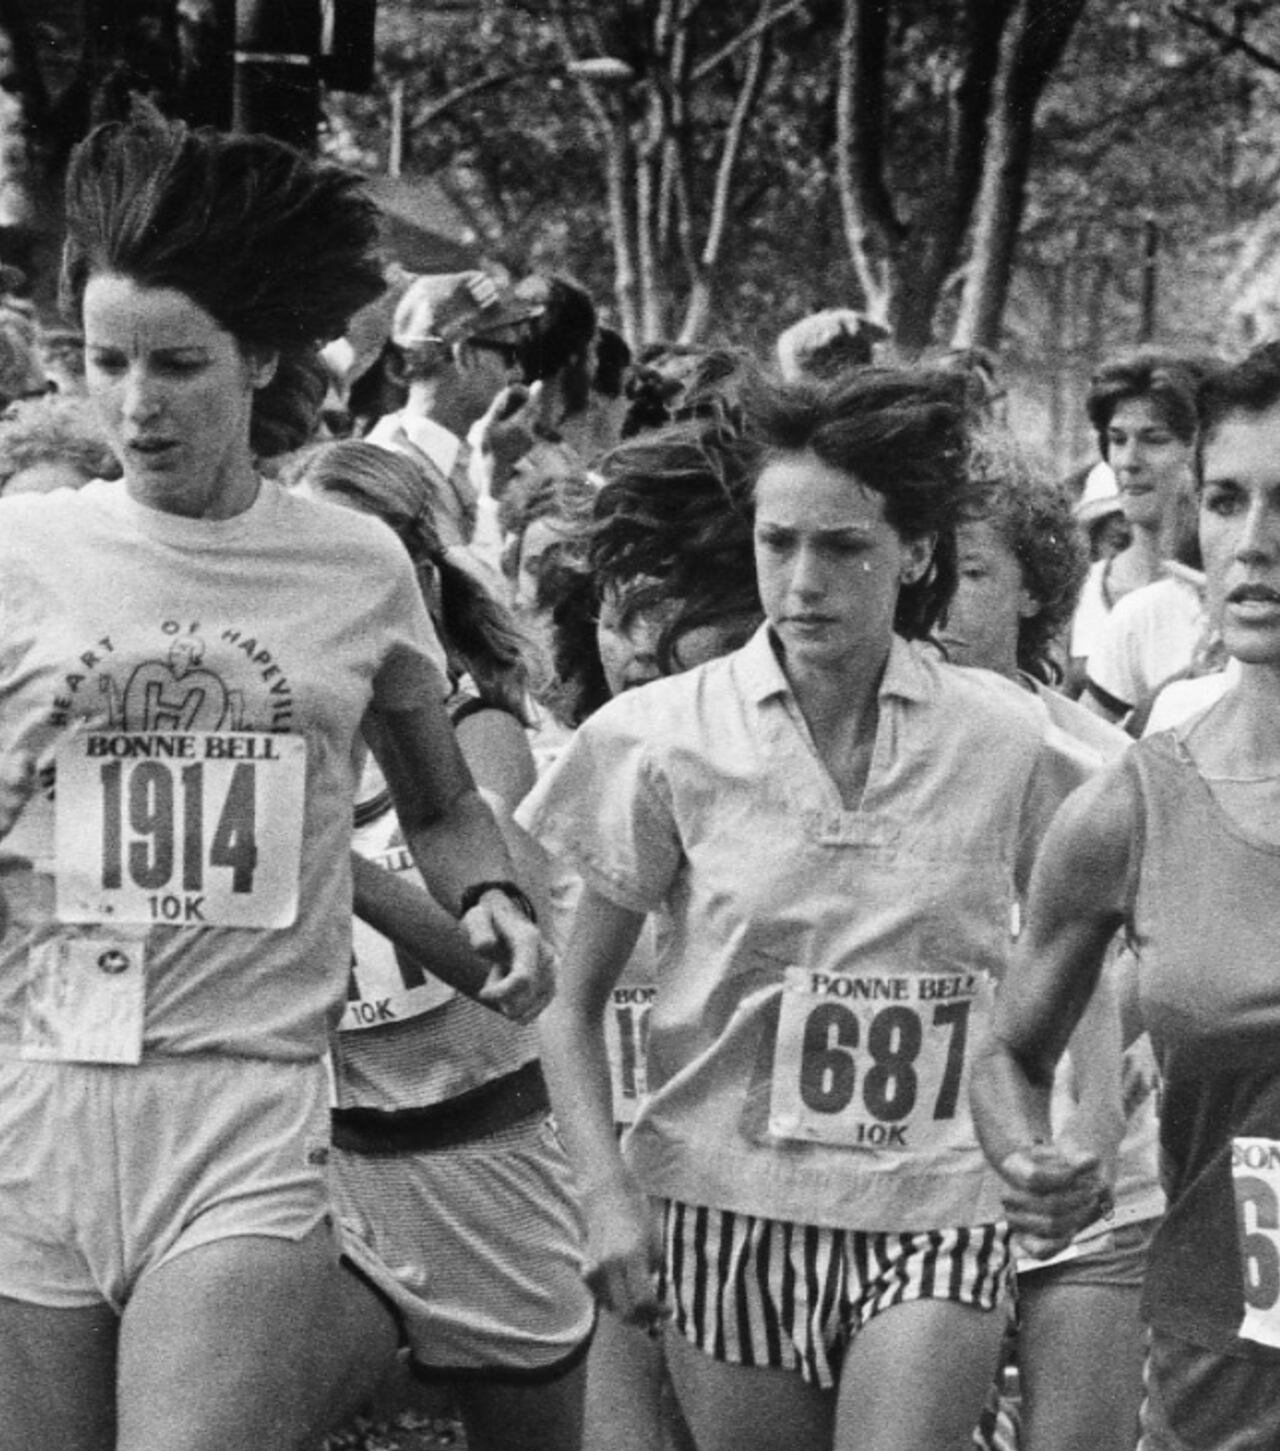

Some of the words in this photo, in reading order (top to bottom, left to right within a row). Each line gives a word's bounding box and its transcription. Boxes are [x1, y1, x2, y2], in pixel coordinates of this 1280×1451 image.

[49, 634, 114, 727] HEART
[221, 628, 294, 733] HAPEVILL
[86, 735, 196, 760] BONNE
[204, 735, 280, 760] BELL
[100, 761, 259, 894] 1914
[148, 895, 206, 921] 10K
[810, 972, 909, 1000] BONNE
[350, 996, 397, 1025] 10K
[800, 1000, 973, 1121] 687
[856, 1123, 908, 1146] 10K
